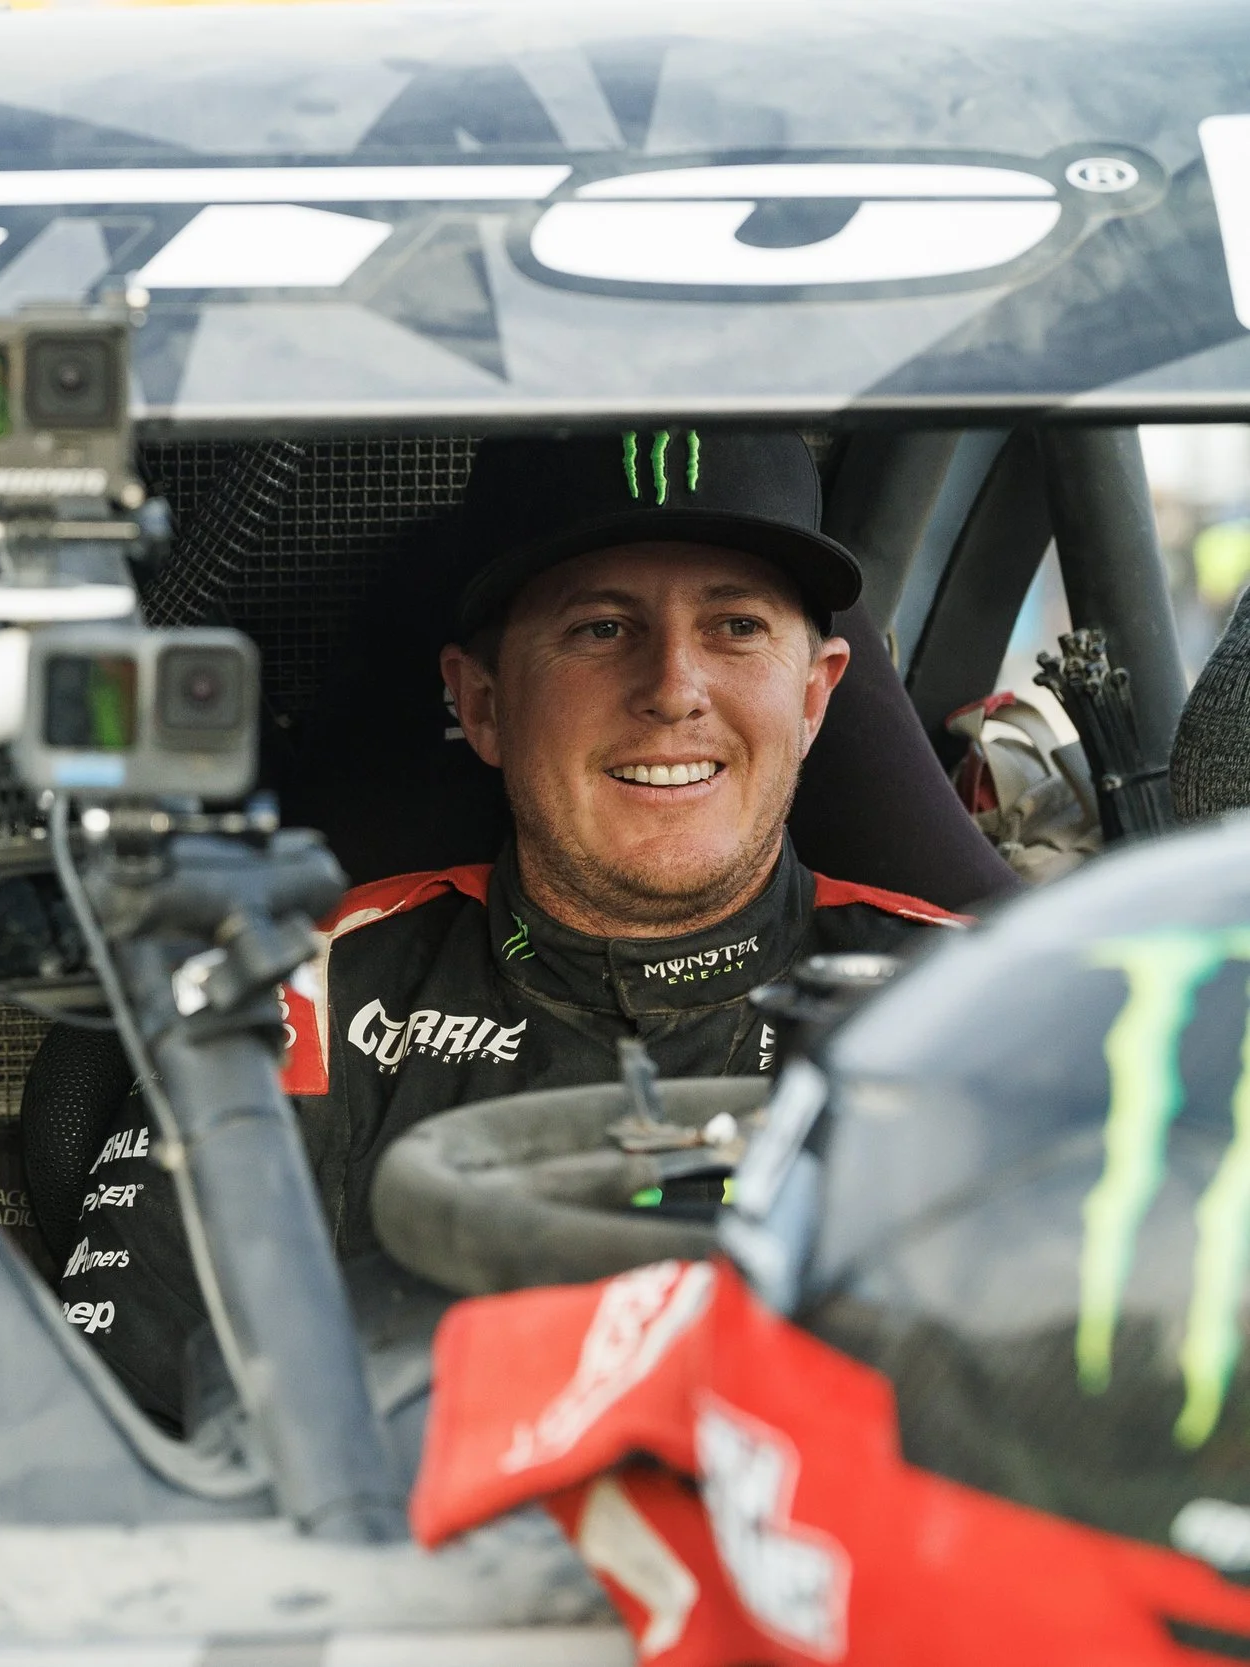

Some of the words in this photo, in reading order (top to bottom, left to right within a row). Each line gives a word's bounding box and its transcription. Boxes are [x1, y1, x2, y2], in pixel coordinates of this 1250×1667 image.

[643, 935, 760, 979] MONSTER
[667, 960, 744, 985] ENERGY
[347, 998, 527, 1066] CURRIE
[378, 1044, 501, 1075] ENERPRISES
[89, 1126, 149, 1175] AHLE
